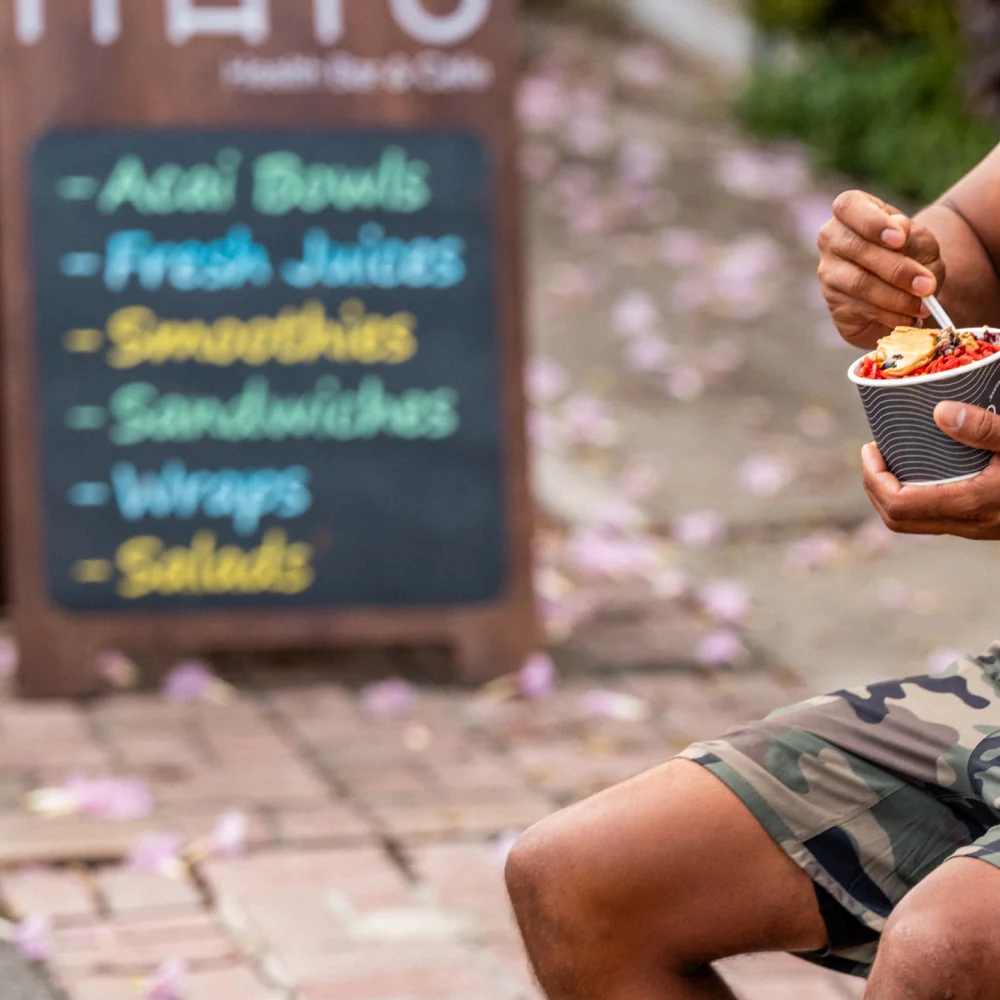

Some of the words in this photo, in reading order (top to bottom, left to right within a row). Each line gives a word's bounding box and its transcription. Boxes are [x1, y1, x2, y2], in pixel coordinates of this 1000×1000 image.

[252, 146, 430, 215] Bowls
[105, 224, 272, 290] Fresh
[281, 222, 466, 289] Juices
[107, 299, 417, 368] Smoothies
[109, 374, 459, 446] Sandwiches
[110, 459, 312, 535] Wraps
[115, 530, 314, 598] Salads
